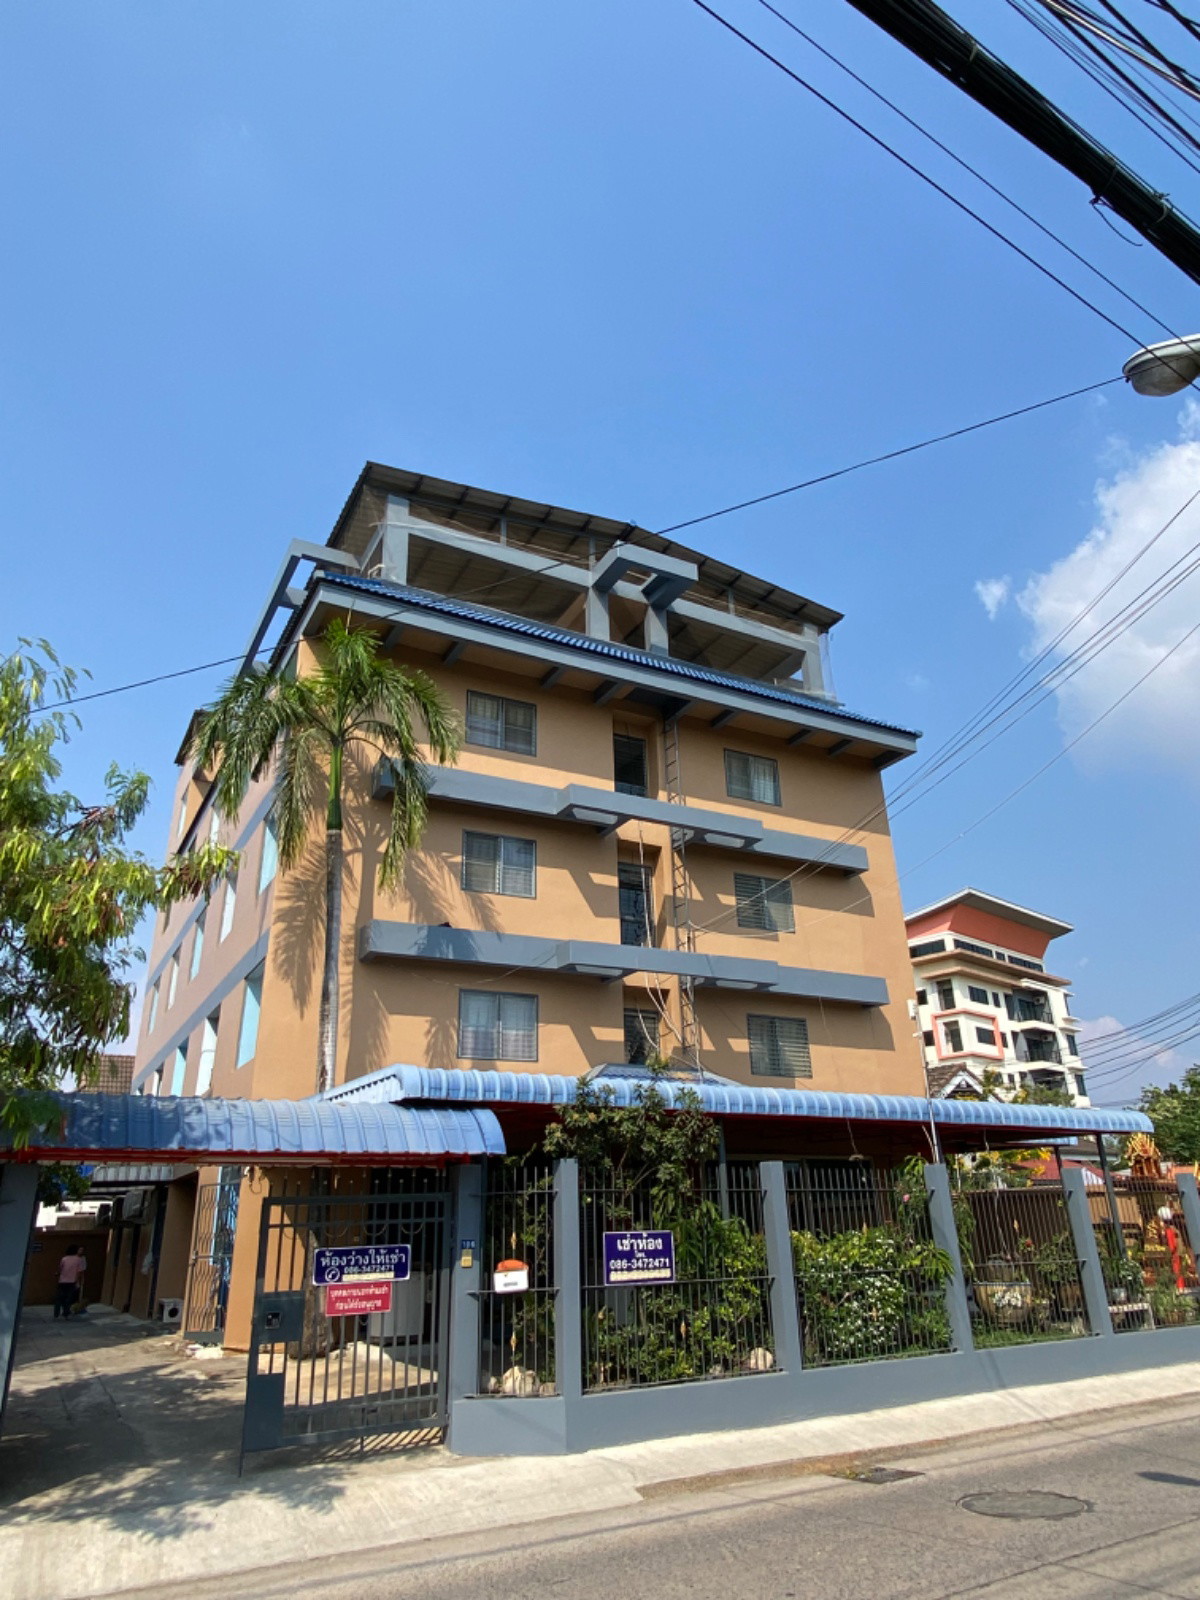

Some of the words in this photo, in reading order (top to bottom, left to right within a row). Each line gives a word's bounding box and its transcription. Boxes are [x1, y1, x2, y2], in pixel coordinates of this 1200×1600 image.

[617, 1232, 662, 1251] เช่าห้อง
[320, 1249, 405, 1266] ห้องว่างให้เช่า
[609, 1258, 669, 1268] 086-3472471
